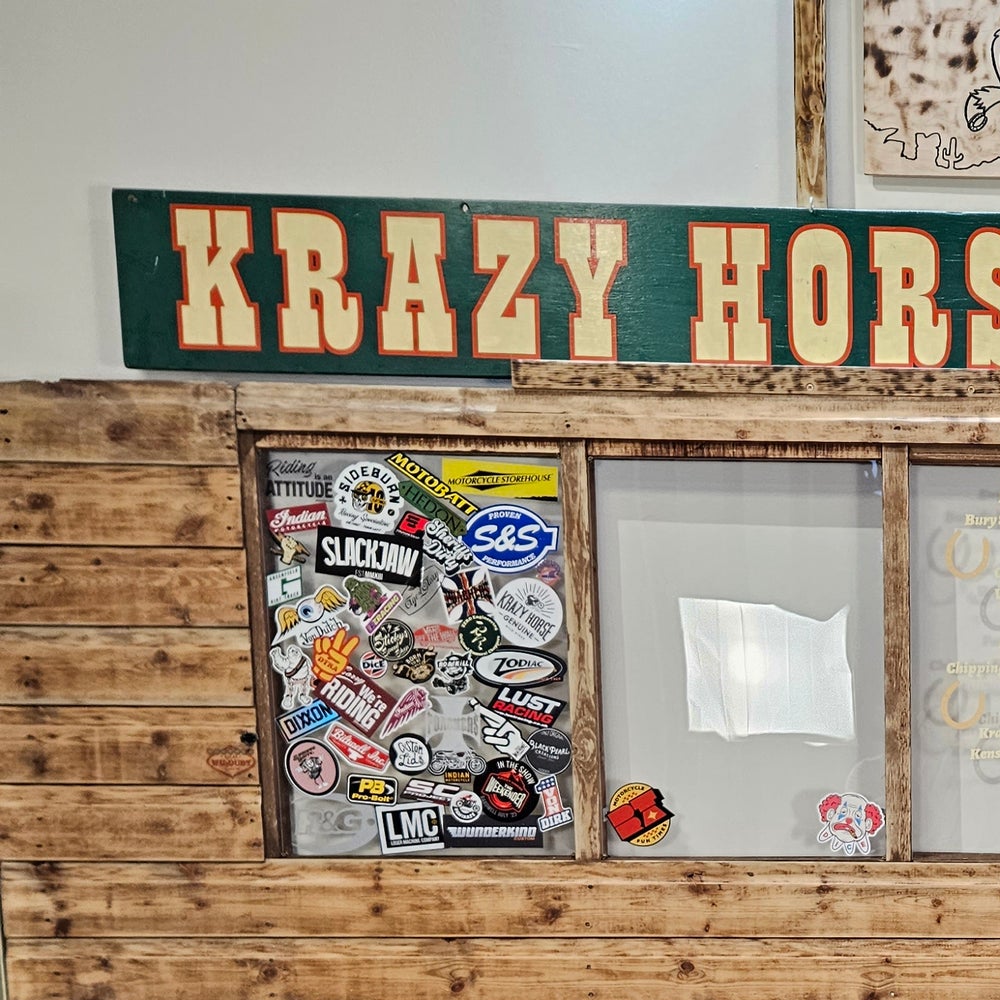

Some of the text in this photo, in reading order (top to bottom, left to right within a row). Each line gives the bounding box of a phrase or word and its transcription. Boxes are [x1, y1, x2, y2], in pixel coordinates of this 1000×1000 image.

[169, 203, 628, 361] KRAZY
[267, 459, 317, 477] Riding
[448, 473, 553, 485] MOTORCYCLE STOREHOUSE
[266, 480, 333, 498] ATTITUDE
[339, 466, 400, 504] SIDEBURN
[390, 452, 478, 516] MOTOBATT
[270, 509, 327, 528] Indian
[488, 511, 521, 520] PROVEN
[965, 514, 997, 527] Bury
[472, 524, 540, 552] S&S
[321, 536, 419, 577] SLACKJAW
[481, 553, 536, 568] PERFORMANCE
[317, 617, 344, 636] Dutch
[497, 591, 526, 618] KRAZY
[525, 613, 555, 641] HORSE
[503, 614, 533, 639] GENUINE
[493, 657, 543, 676] ZODIAC
[321, 679, 380, 729] RIDING
[359, 684, 387, 713] We're
[498, 687, 561, 714] LUST
[284, 703, 333, 734] DIXXON
[492, 700, 553, 725] RACING
[505, 760, 518, 770] THE
[518, 766, 536, 785] SHOW
[352, 793, 390, 803] Pro-Bolt
[359, 779, 385, 794] PB
[406, 779, 460, 795] SC
[486, 776, 527, 809] WEEKENDER
[613, 785, 645, 806] MOTORCYCLE
[388, 809, 438, 841] LMC
[540, 810, 572, 829] DIRK
[652, 823, 667, 842] TIMES
